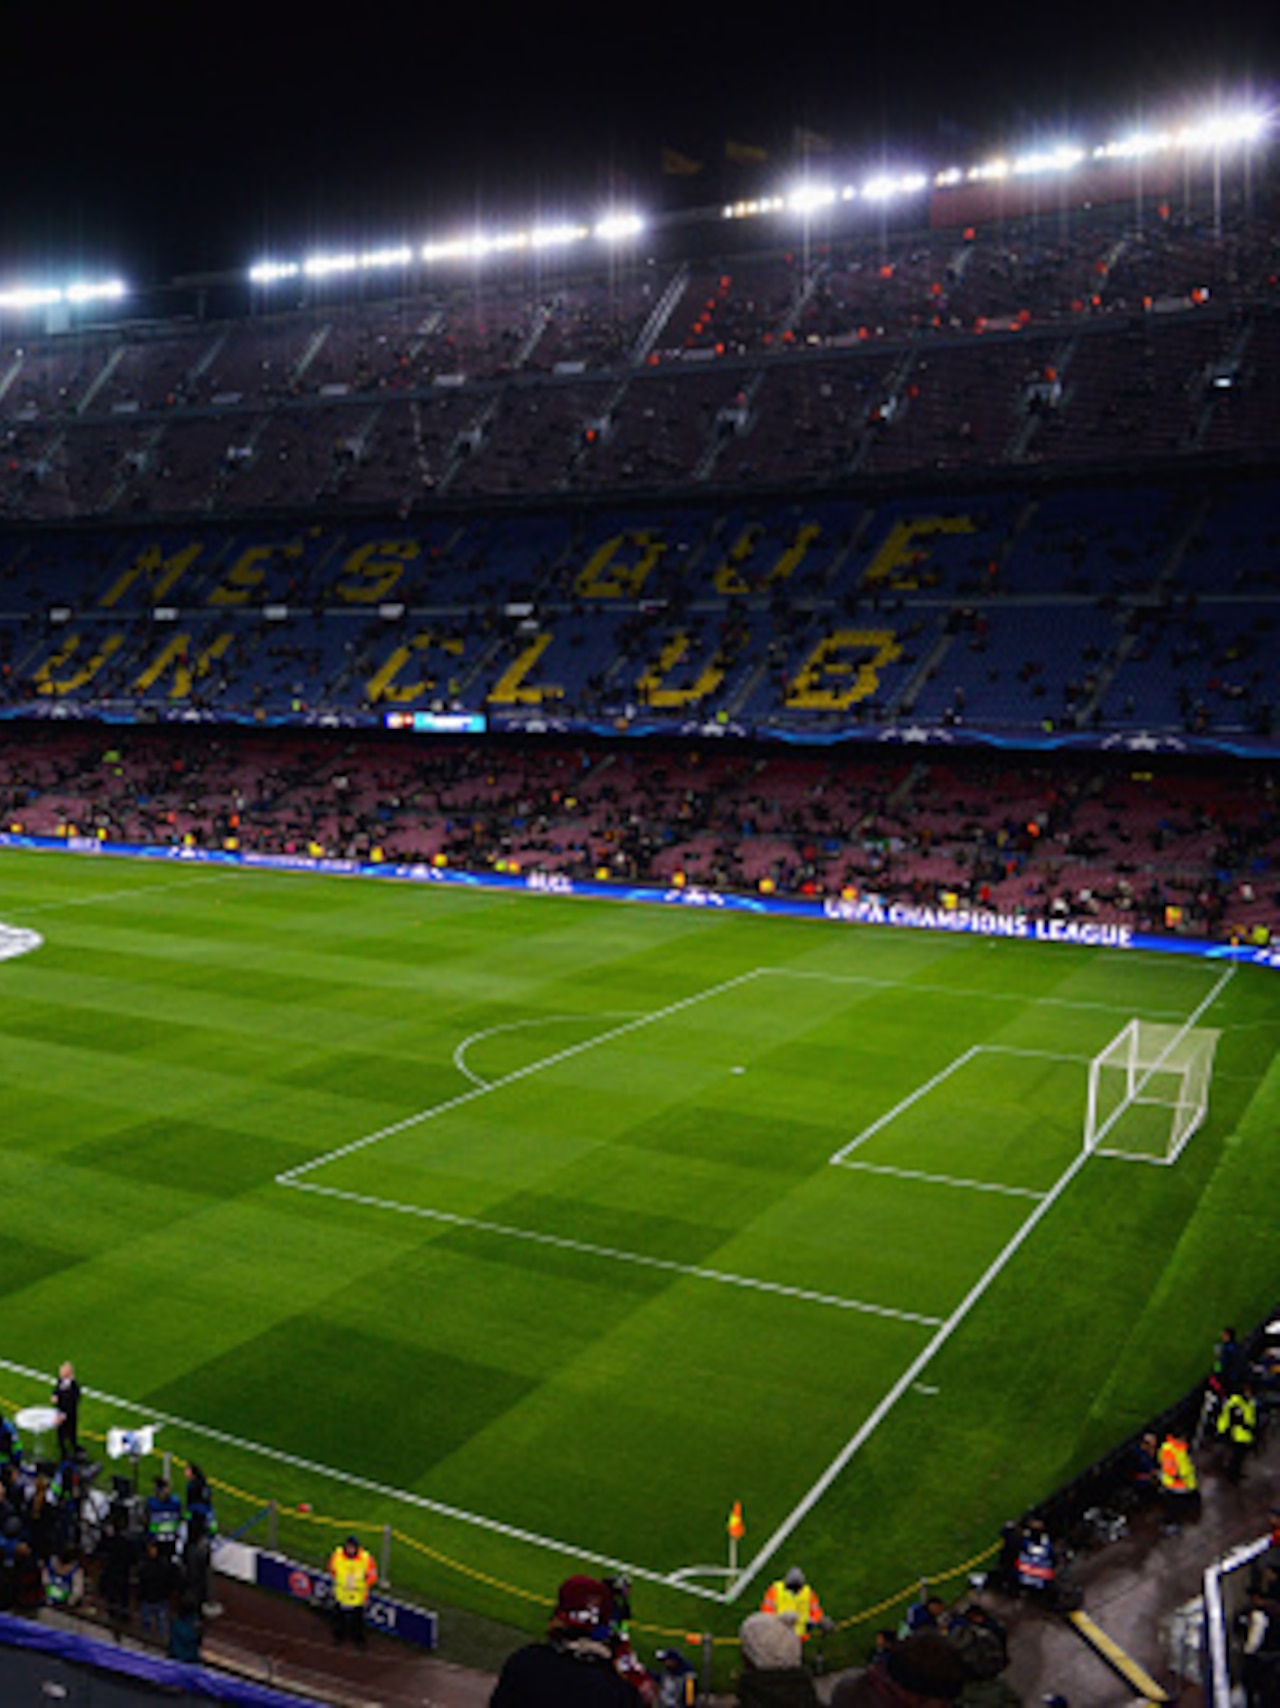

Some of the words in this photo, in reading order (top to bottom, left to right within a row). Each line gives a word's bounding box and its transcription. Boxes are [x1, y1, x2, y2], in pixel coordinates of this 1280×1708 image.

[33, 633, 234, 699] UN
[367, 631, 903, 710] CLUB
[889, 902, 1028, 938] CHAMPIONS
[1036, 918, 1135, 948] LEAGUE
